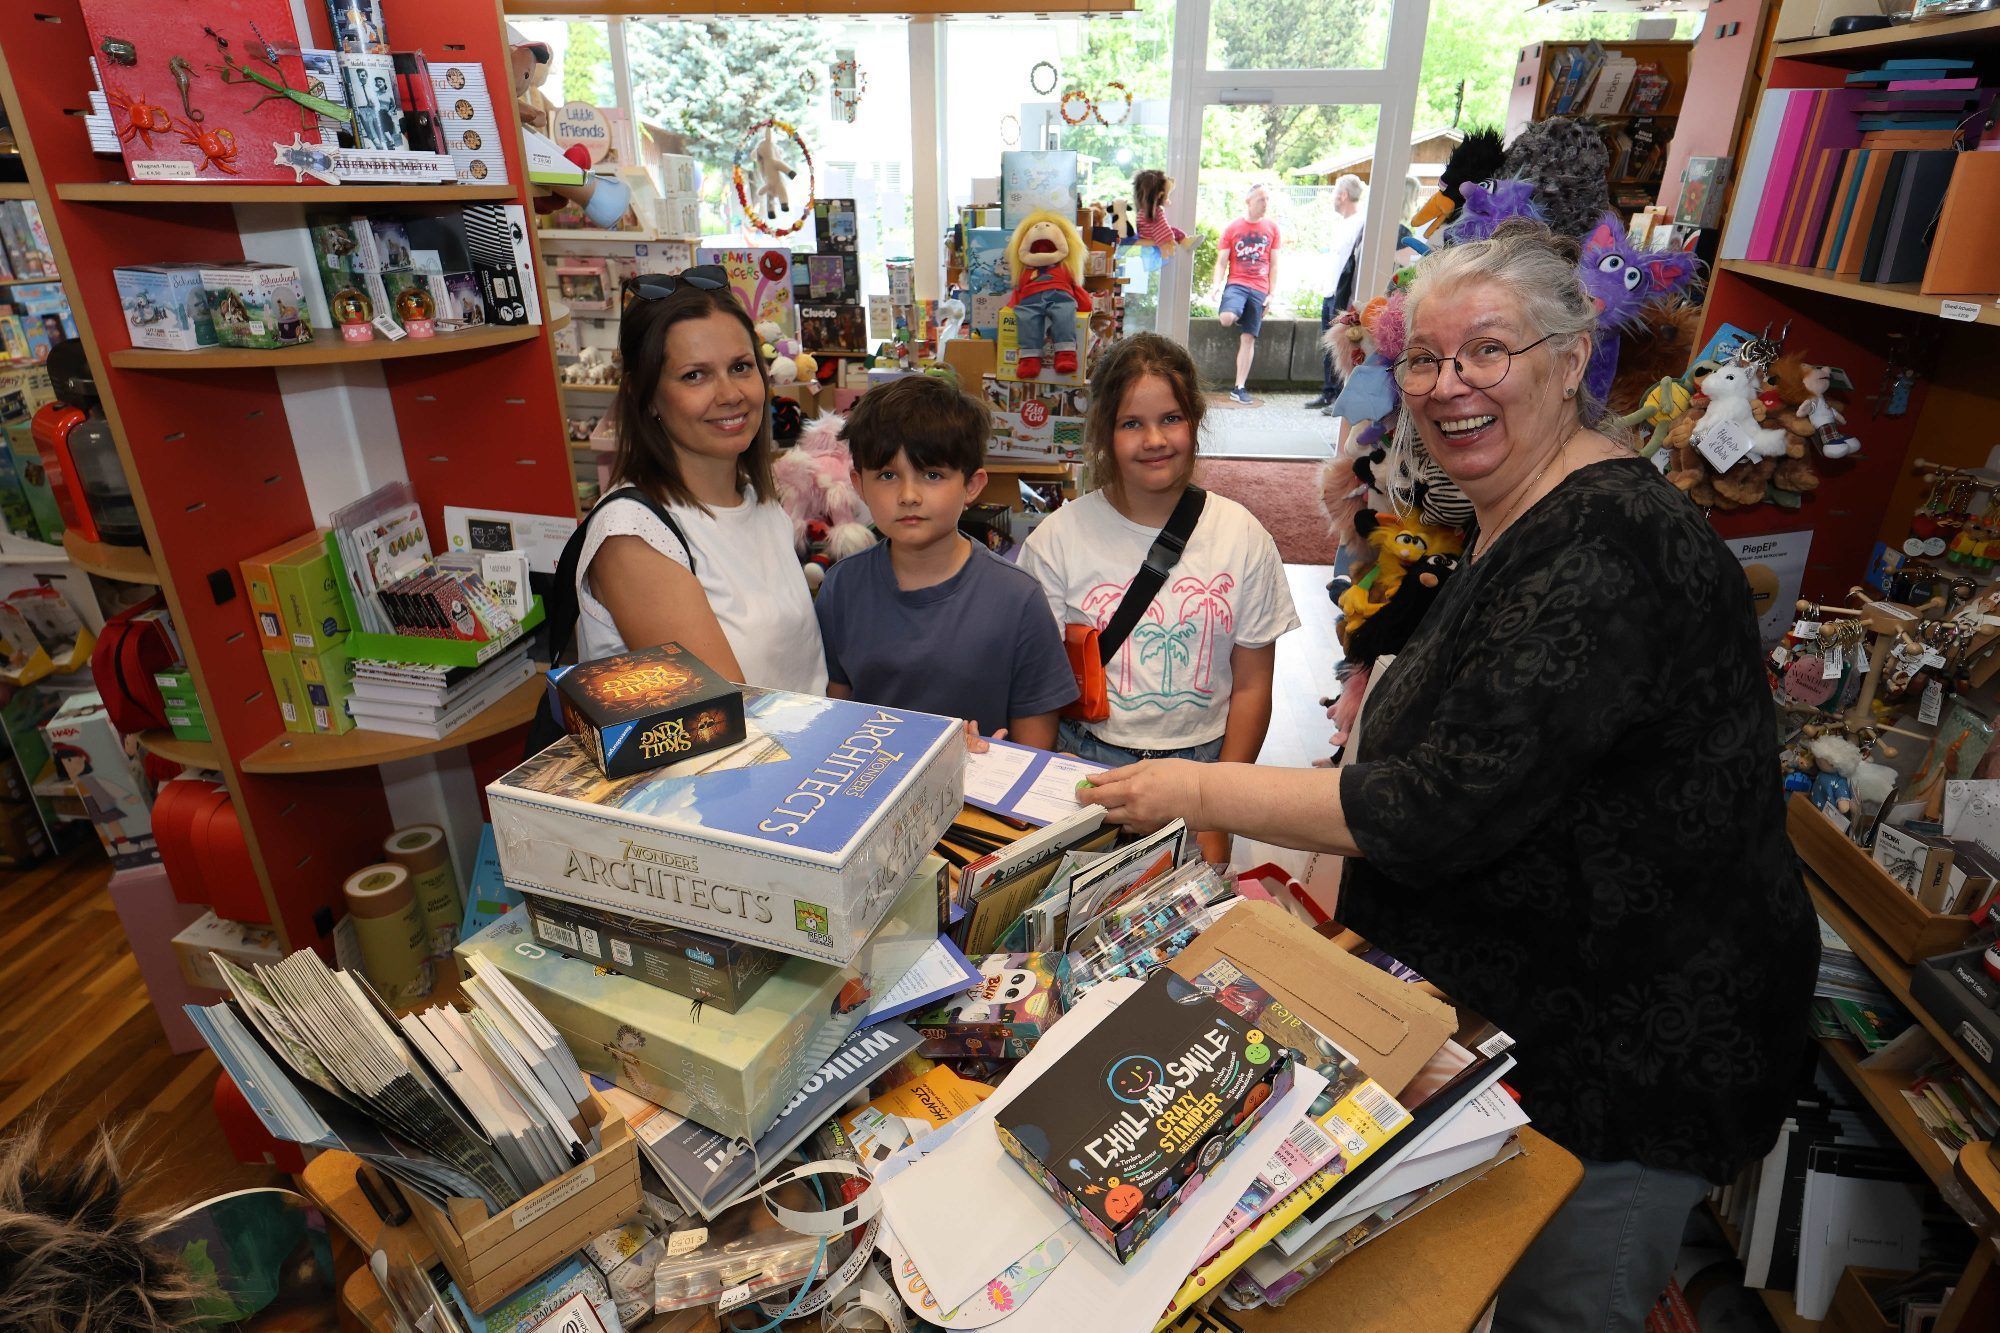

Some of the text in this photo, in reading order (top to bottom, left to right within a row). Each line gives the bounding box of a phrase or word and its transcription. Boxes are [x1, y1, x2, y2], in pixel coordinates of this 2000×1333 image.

[1600, 72, 1623, 109] Farben
[566, 107, 594, 120] Little
[559, 122, 605, 139] Friends
[401, 162, 438, 171] METER
[713, 251, 754, 264] BEANIE
[728, 266, 760, 280] NCERS
[801, 307, 837, 319] Cluedo
[1003, 316, 1017, 326] Pik
[1025, 402, 1045, 415] Zig
[602, 674, 689, 699] SKULL
[603, 665, 670, 688] KING
[640, 717, 685, 745] KING
[638, 731, 693, 760] SKULL
[759, 709, 905, 839] ARCHITECTS
[844, 747, 903, 798] 7 WONDERS
[618, 839, 700, 874] 7 WONDERS
[562, 848, 774, 925] ARCHITECTS
[1265, 999, 1303, 1030] alea
[1139, 1083, 1176, 1119] AND
[1156, 1090, 1201, 1133] CRAZY
[1159, 1092, 1224, 1154] STAMPER
[1119, 1153, 1142, 1167] Timbre
[1134, 1169, 1154, 1181] Sellos
[800, 1293, 823, 1310] 22,99
[572, 1307, 592, 1333] Schmidt
